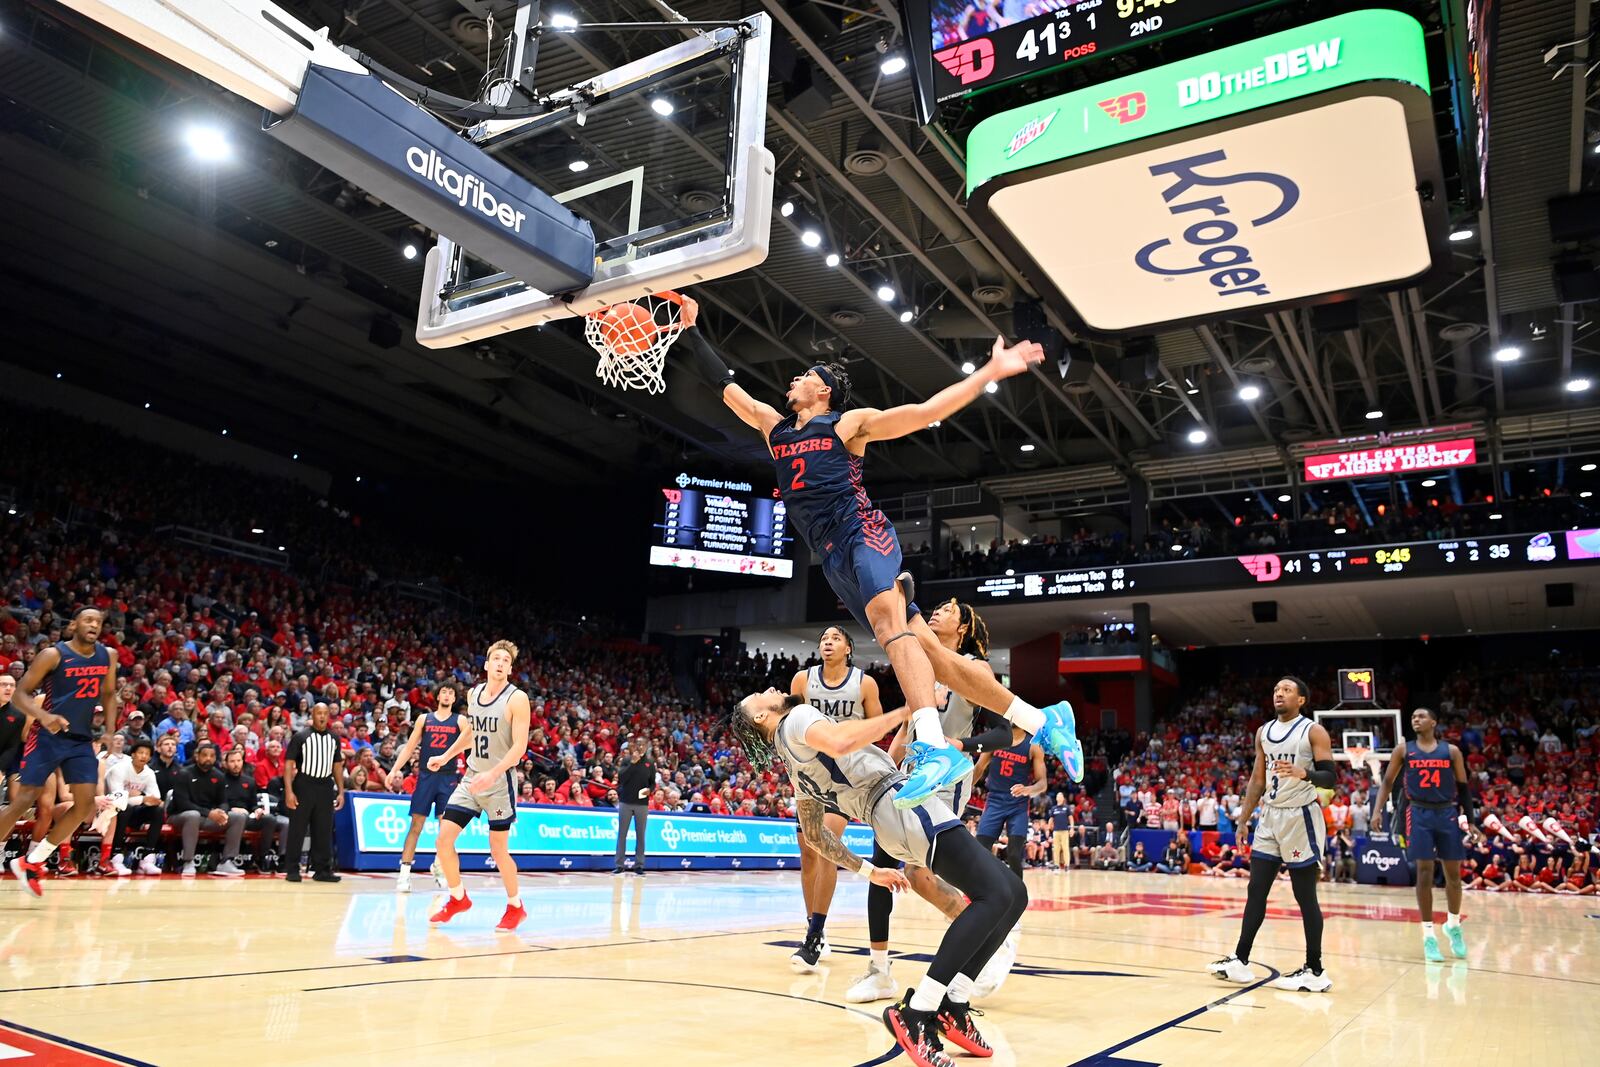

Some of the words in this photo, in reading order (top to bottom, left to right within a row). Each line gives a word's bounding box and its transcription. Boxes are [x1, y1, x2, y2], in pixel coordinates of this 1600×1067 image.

[1055, 10, 1071, 20] TOL
[1116, 0, 1177, 18] 9:
[1130, 15, 1163, 37] 2ND
[1015, 23, 1057, 62] 41
[1059, 21, 1072, 39] 3
[1086, 12, 1097, 31] 1
[1063, 42, 1097, 60] POSS
[1176, 71, 1221, 107] DO
[1221, 66, 1265, 92] THE
[1264, 37, 1342, 84] DEW
[406, 147, 526, 233] altafiber
[1135, 149, 1300, 297] Kroger
[773, 438, 833, 460] FLYERS
[1339, 452, 1368, 464] THE
[1374, 445, 1437, 460] CONNOR
[1320, 457, 1397, 478] FLIGHT
[1401, 449, 1459, 470] DECK
[791, 457, 807, 490] 2
[691, 477, 723, 488] Premier
[724, 481, 752, 492] Health
[704, 506, 723, 515] FIELD
[723, 508, 741, 517] GOAL
[741, 510, 748, 518] %
[714, 515, 735, 524] POINT
[706, 523, 743, 534] REBOUNDS
[700, 531, 718, 540] FREE
[718, 533, 748, 543] THROWS
[703, 540, 744, 551] TURNOVERS
[1489, 544, 1511, 559] 35
[1375, 548, 1411, 564] 9:45
[1445, 551, 1455, 563] 3
[1469, 549, 1479, 561] 2
[1284, 559, 1302, 573] 41
[1312, 561, 1321, 573] 3
[1334, 560, 1342, 571] 1
[1055, 573, 1089, 584] Louisiana
[1089, 570, 1107, 581] Tech
[1056, 584, 1082, 594] Texas
[1082, 582, 1105, 592] Tech
[1111, 579, 1124, 590] 64
[64, 666, 109, 677] FLYERS
[75, 678, 100, 698] 23
[425, 725, 457, 734] FLYERS
[430, 733, 449, 748] 22
[474, 735, 489, 759] 12
[999, 760, 1015, 777] 15
[1408, 759, 1450, 769] FLYERS
[1419, 769, 1441, 788] 24
[1269, 775, 1280, 800] 3
[538, 823, 561, 838] Our
[562, 824, 588, 839] Care
[680, 828, 716, 842] Premier
[716, 829, 747, 844] Health
[759, 832, 774, 844] Our
[1361, 849, 1400, 871] Kroger
